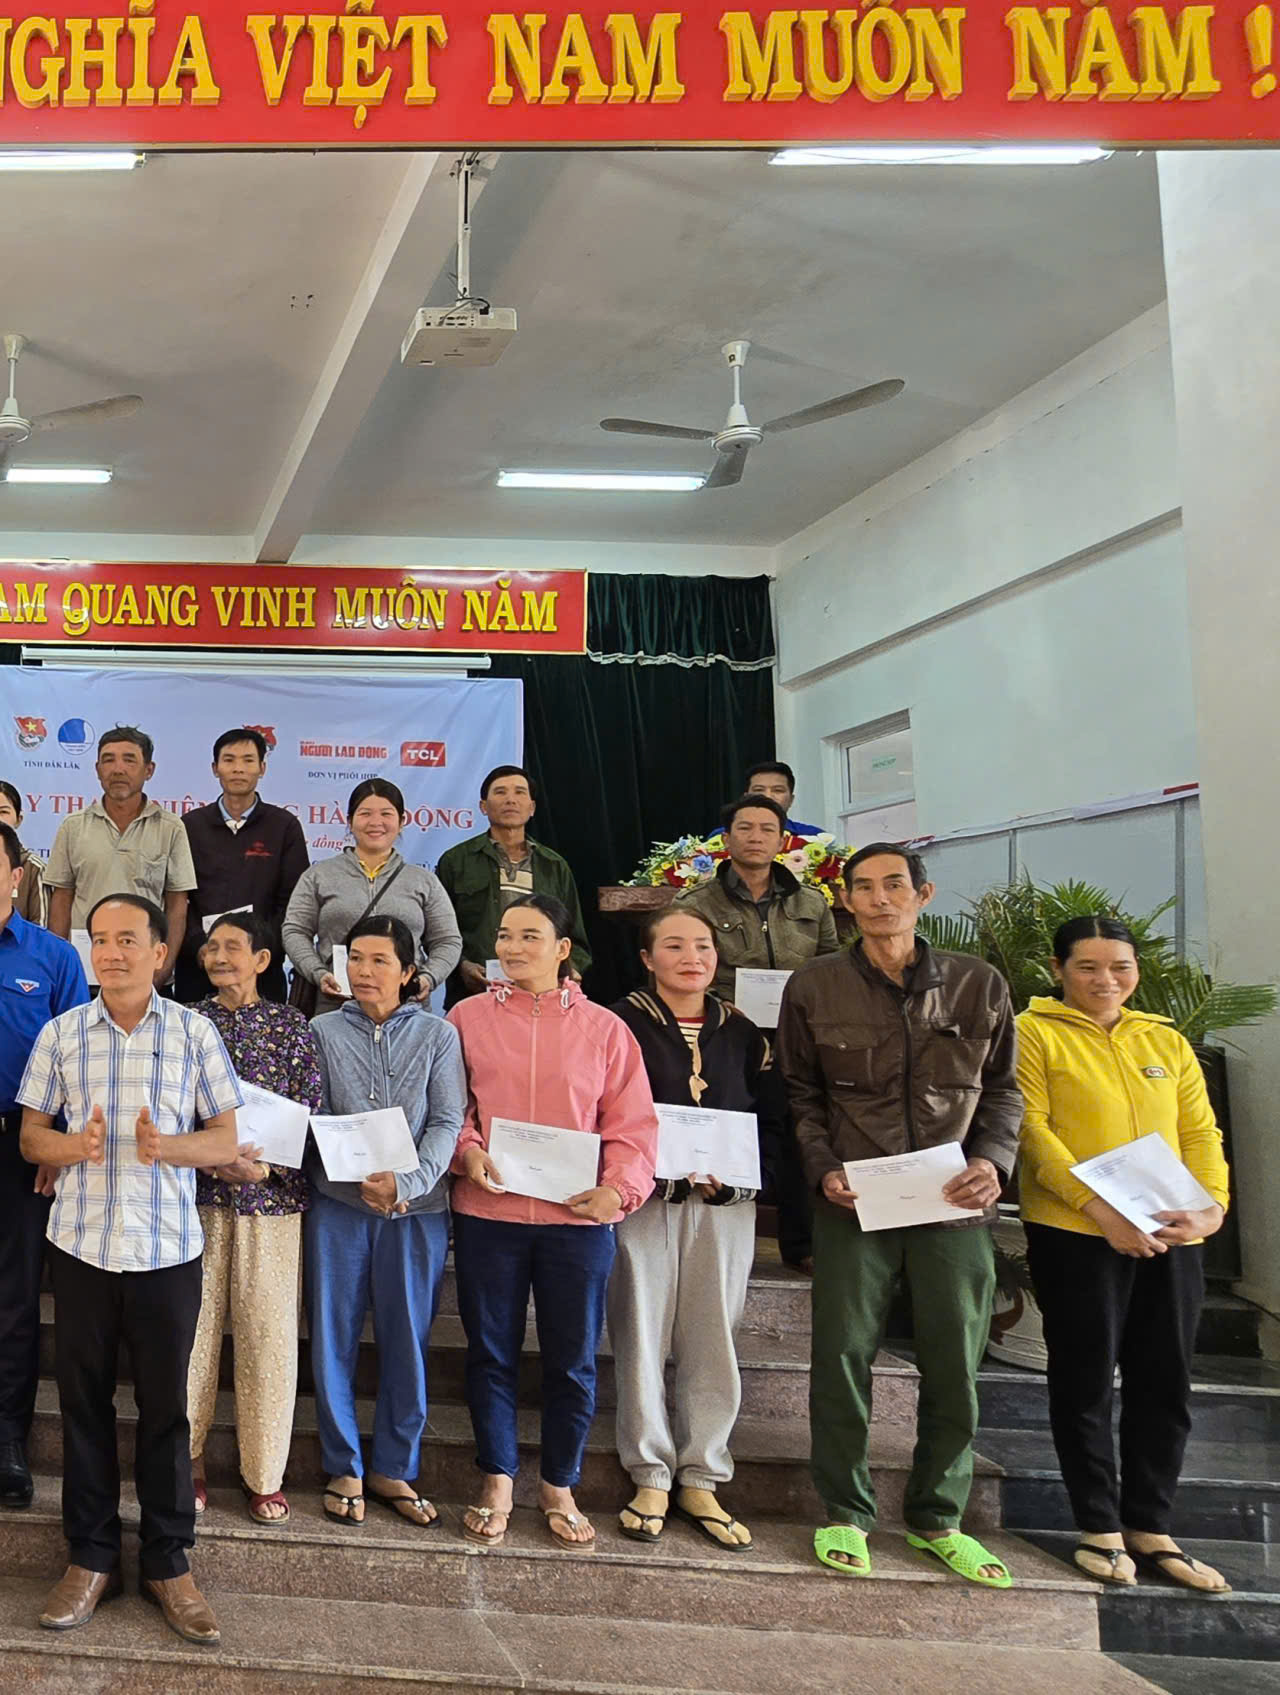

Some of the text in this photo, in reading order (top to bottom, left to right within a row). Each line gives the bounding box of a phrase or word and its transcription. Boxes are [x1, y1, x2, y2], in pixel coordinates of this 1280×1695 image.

[246, 0, 448, 129] VIỆT
[486, 12, 687, 106] NAM
[720, 0, 968, 104] MUÔN
[61, 581, 201, 637] QUANG
[210, 584, 318, 630] VINH
[332, 579, 448, 632] MUÔN
[461, 578, 560, 633] NĂM
[407, 749, 440, 761] TCL
